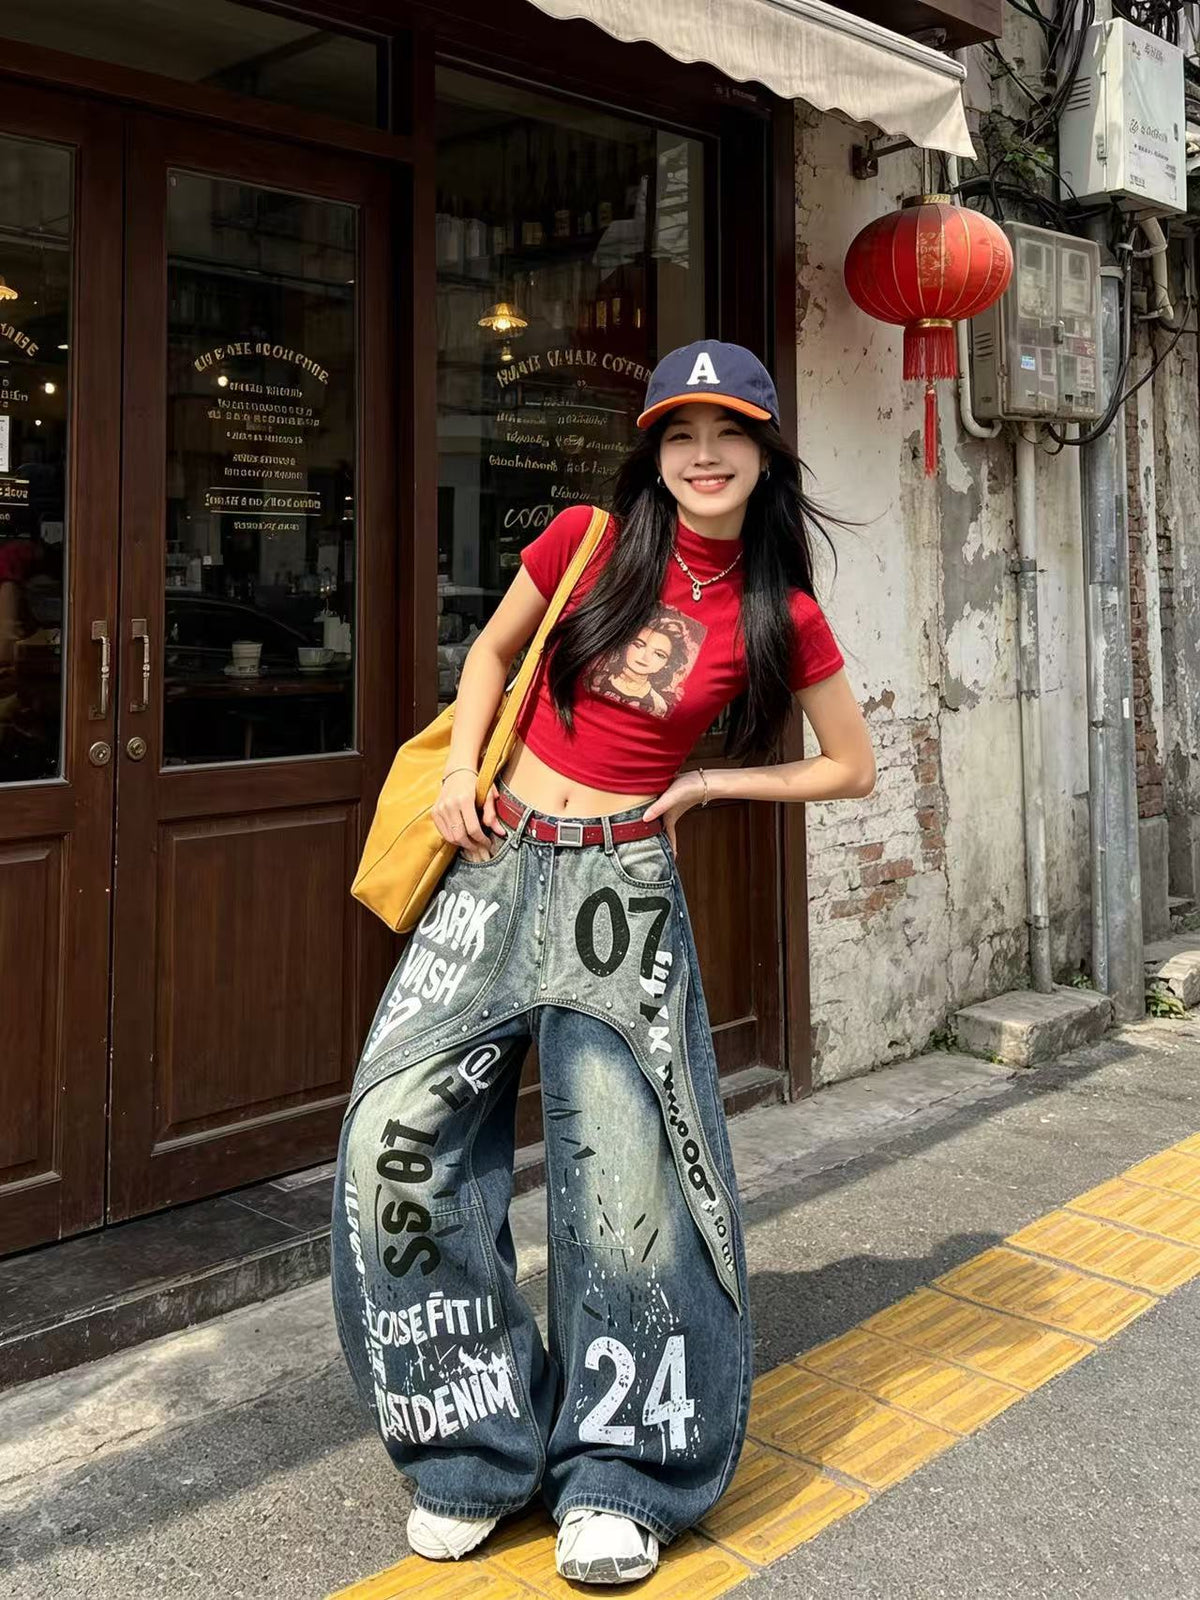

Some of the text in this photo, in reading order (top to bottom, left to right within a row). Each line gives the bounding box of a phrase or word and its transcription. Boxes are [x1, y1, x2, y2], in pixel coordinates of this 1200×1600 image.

[686, 352, 720, 385] A
[575, 886, 671, 980] 07
[411, 1353, 520, 1443] DENIM
[578, 1335, 695, 1450] 24
